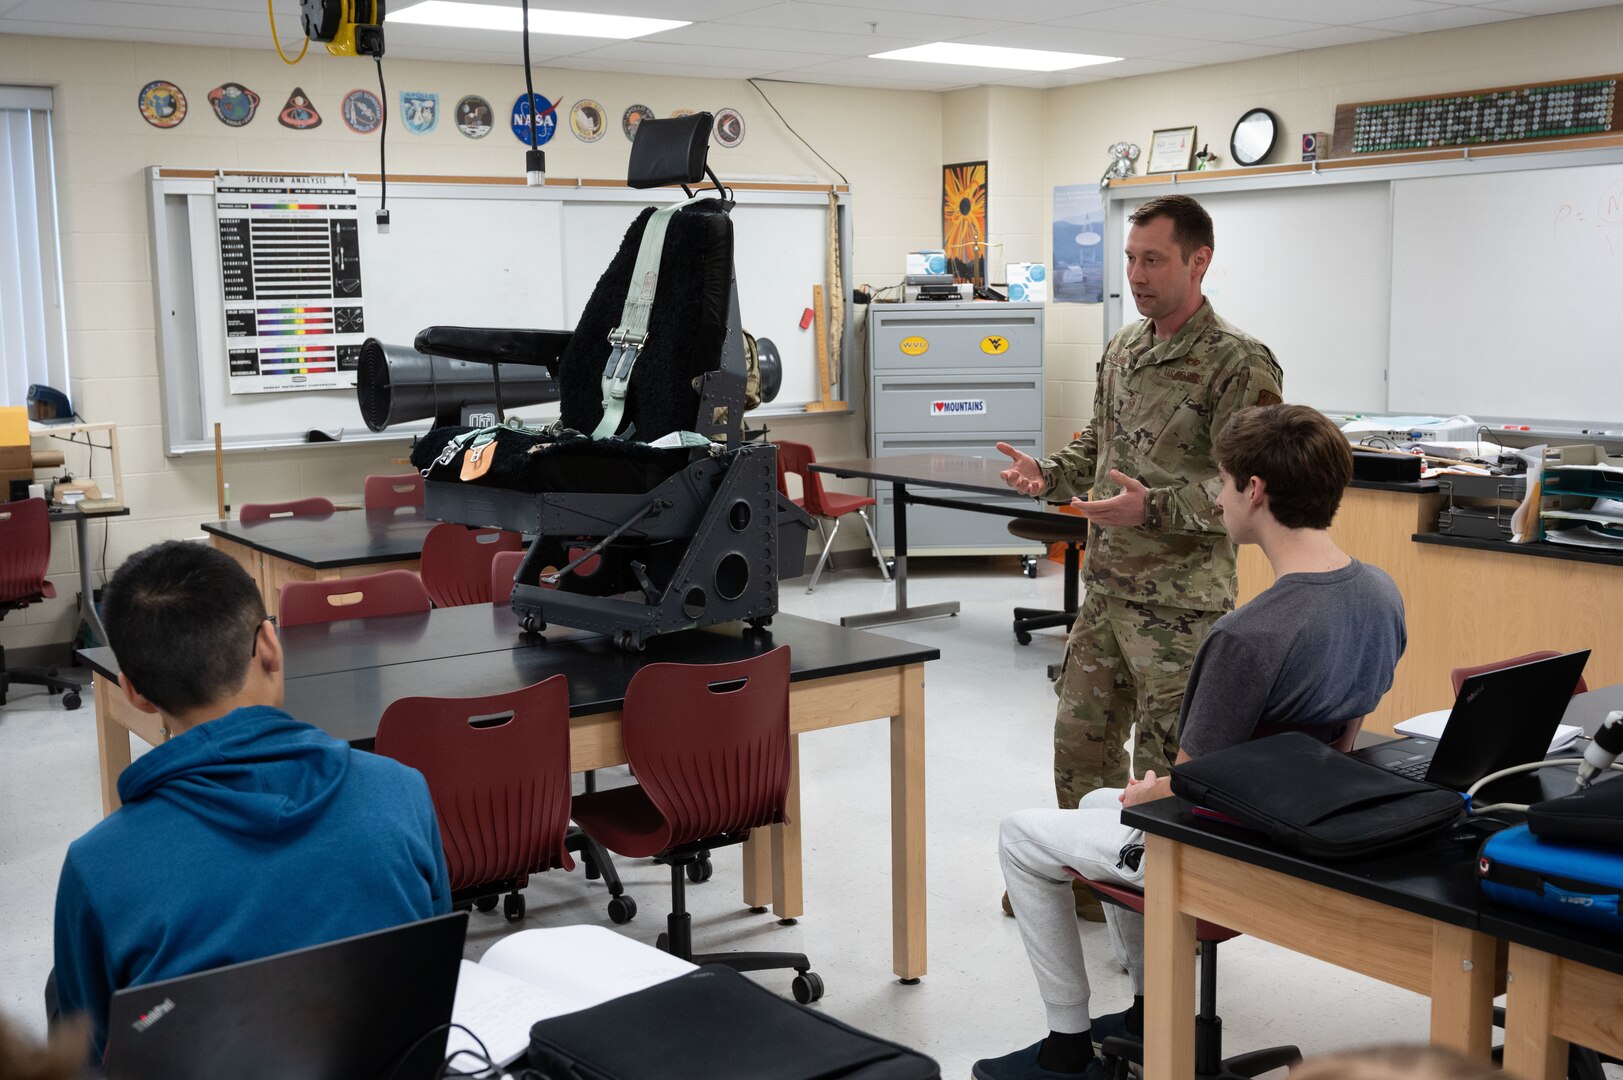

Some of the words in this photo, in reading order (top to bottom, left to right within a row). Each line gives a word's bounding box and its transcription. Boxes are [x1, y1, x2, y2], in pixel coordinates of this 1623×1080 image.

[513, 113, 554, 127] NASA
[944, 401, 983, 412] MOUNTAINS
[132, 998, 175, 1032] ThinkPad
